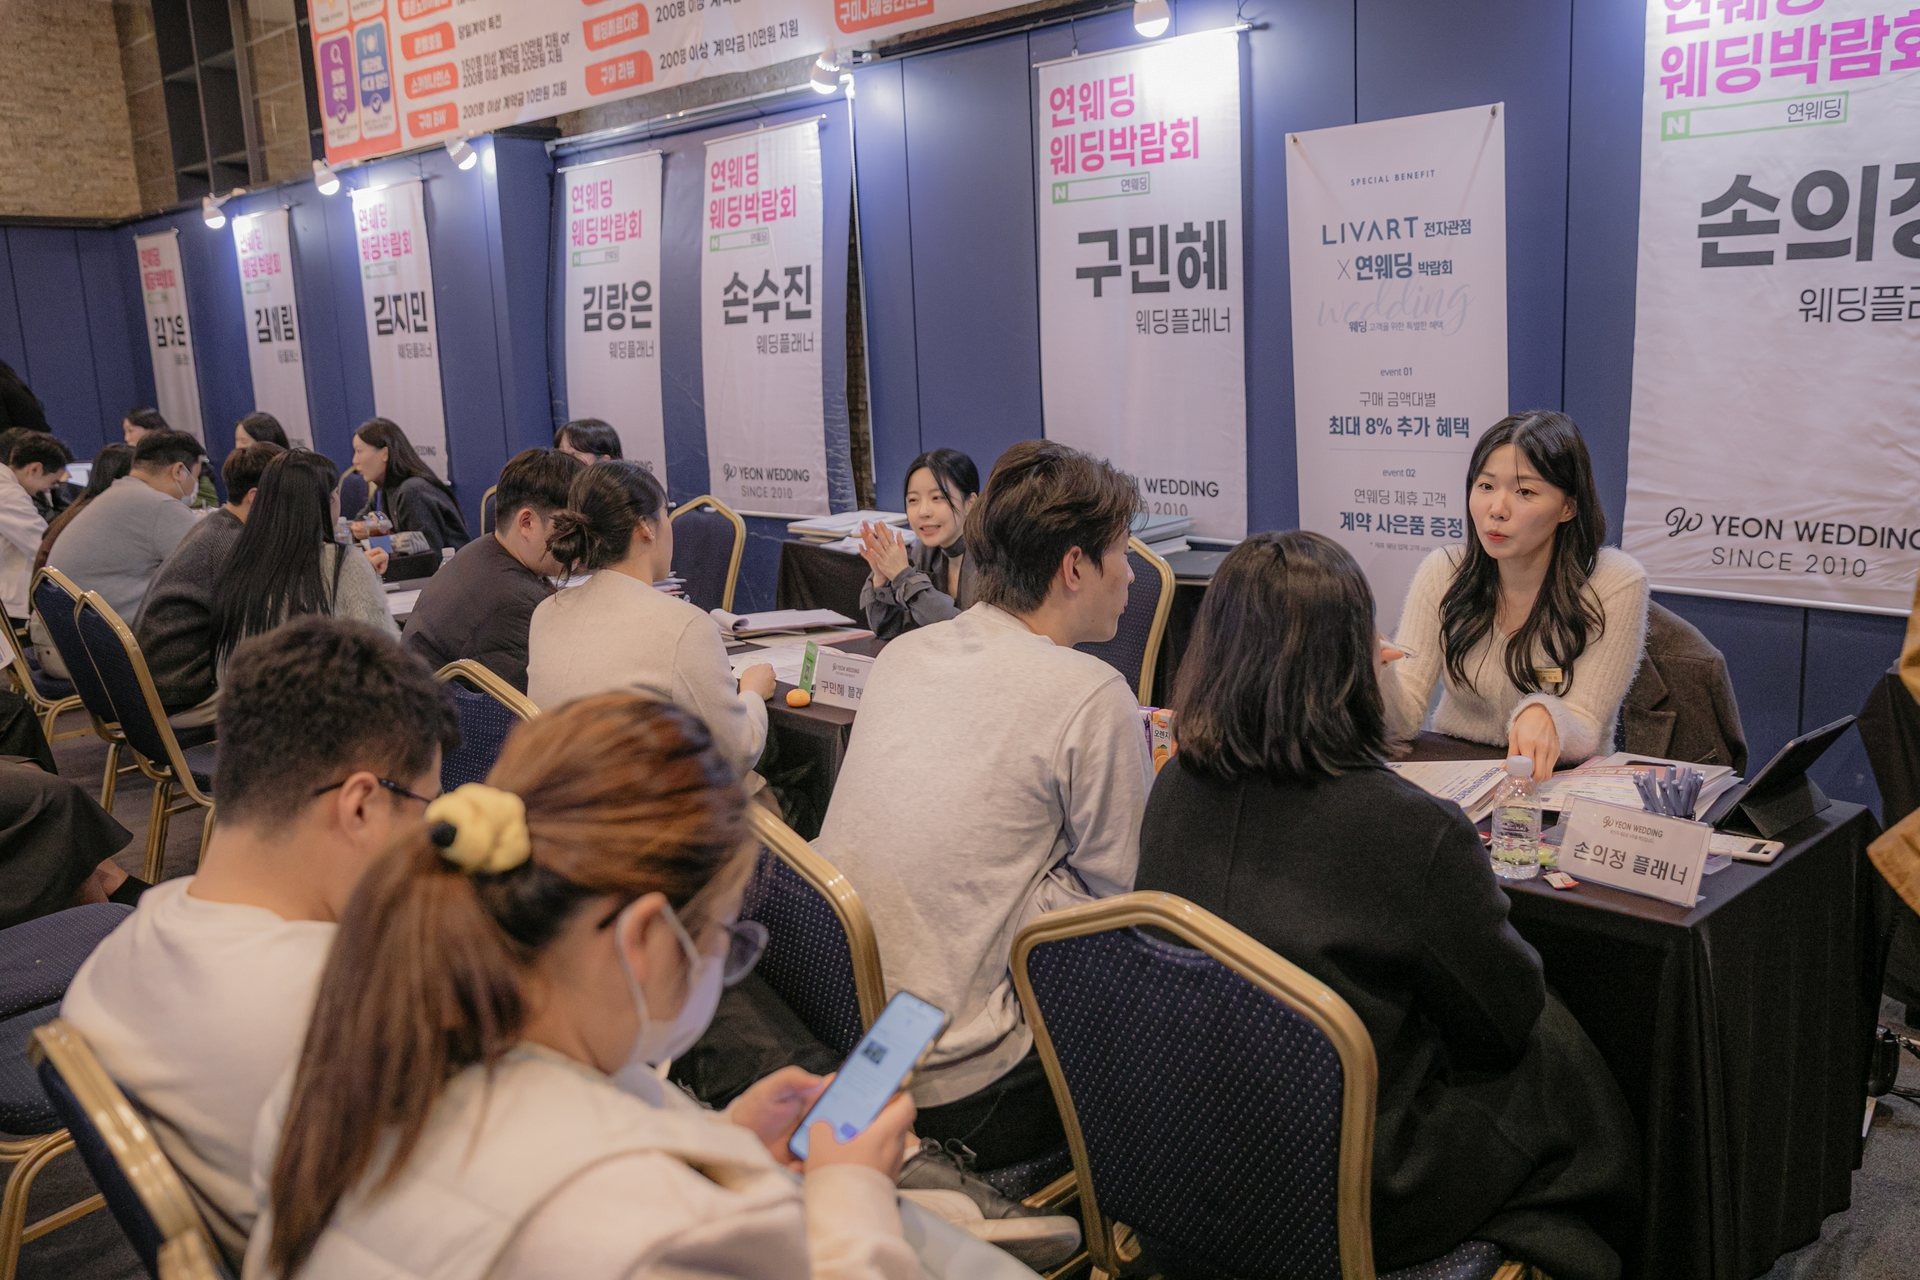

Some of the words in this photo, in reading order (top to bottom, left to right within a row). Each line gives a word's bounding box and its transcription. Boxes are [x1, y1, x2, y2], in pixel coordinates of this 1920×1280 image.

[656, 2, 686, 22] 200명
[561, 32, 570, 44] or
[660, 51, 687, 70] 200명
[689, 43, 709, 61] 이상
[714, 35, 744, 56] 계약금
[747, 26, 776, 50] 10만원
[780, 20, 799, 40] 지원
[1050, 73, 1135, 128] 연웨딩
[1787, 98, 1842, 123] 연웨딩
[1050, 116, 1199, 175] 웨딩박람회
[710, 152, 760, 192] 연웨딩
[1121, 176, 1147, 192] 연웨딩
[1350, 176, 1390, 186] SPECIAL
[1394, 170, 1436, 182] BENEFIT
[572, 180, 613, 214] 연웨딩
[710, 185, 797, 230] 웨딩박람회
[572, 209, 642, 247] 웨딩박람회
[1322, 216, 1419, 246] LIVART
[1424, 218, 1472, 238] 전자관점
[1076, 219, 1228, 298] 구민혜
[1355, 252, 1413, 281] 연웨딩
[1418, 260, 1453, 276] 박람회
[583, 280, 653, 332] 김랑은
[722, 264, 812, 325] 손수진
[374, 291, 428, 336] 김지민
[1136, 307, 1231, 335] 웨딩플래너
[1349, 321, 1367, 333] 웨딩
[610, 340, 654, 359] 웨딩플래너
[757, 332, 814, 354] 웨딩플래너
[1380, 368, 1402, 377] event
[1403, 368, 1412, 376] 01
[1360, 392, 1384, 407] 구매
[1388, 392, 1436, 408] 금액대별
[1330, 416, 1360, 436] 최대
[1366, 418, 1392, 436] 8%
[1397, 416, 1430, 437] 추가
[1436, 416, 1470, 438] 혜택
[739, 466, 764, 481] YEON
[766, 468, 810, 482] WEDDING
[1382, 469, 1404, 478] event
[1406, 468, 1416, 478] 02
[741, 485, 768, 498] SINCE
[772, 487, 792, 498] 2010
[1145, 478, 1220, 498] WEDDING
[1354, 488, 1390, 504] 연웨딩
[1394, 491, 1418, 505] 제휴
[1422, 492, 1446, 508] 고객
[1155, 502, 1188, 516] 2010
[1340, 512, 1372, 532] 계약
[1376, 514, 1424, 536] 사은품
[1430, 516, 1463, 538] 증정
[1711, 514, 1784, 540] YEON
[1711, 546, 1794, 571] SINCE
[1804, 554, 1868, 578] 2010
[822, 680, 844, 696] 구민혜
[848, 686, 864, 700] 플래
[1614, 820, 1632, 830] YEON
[1633, 824, 1664, 838] WEDDING
[1574, 841, 1626, 870] 손의정
[1633, 854, 1688, 885] 플래너
